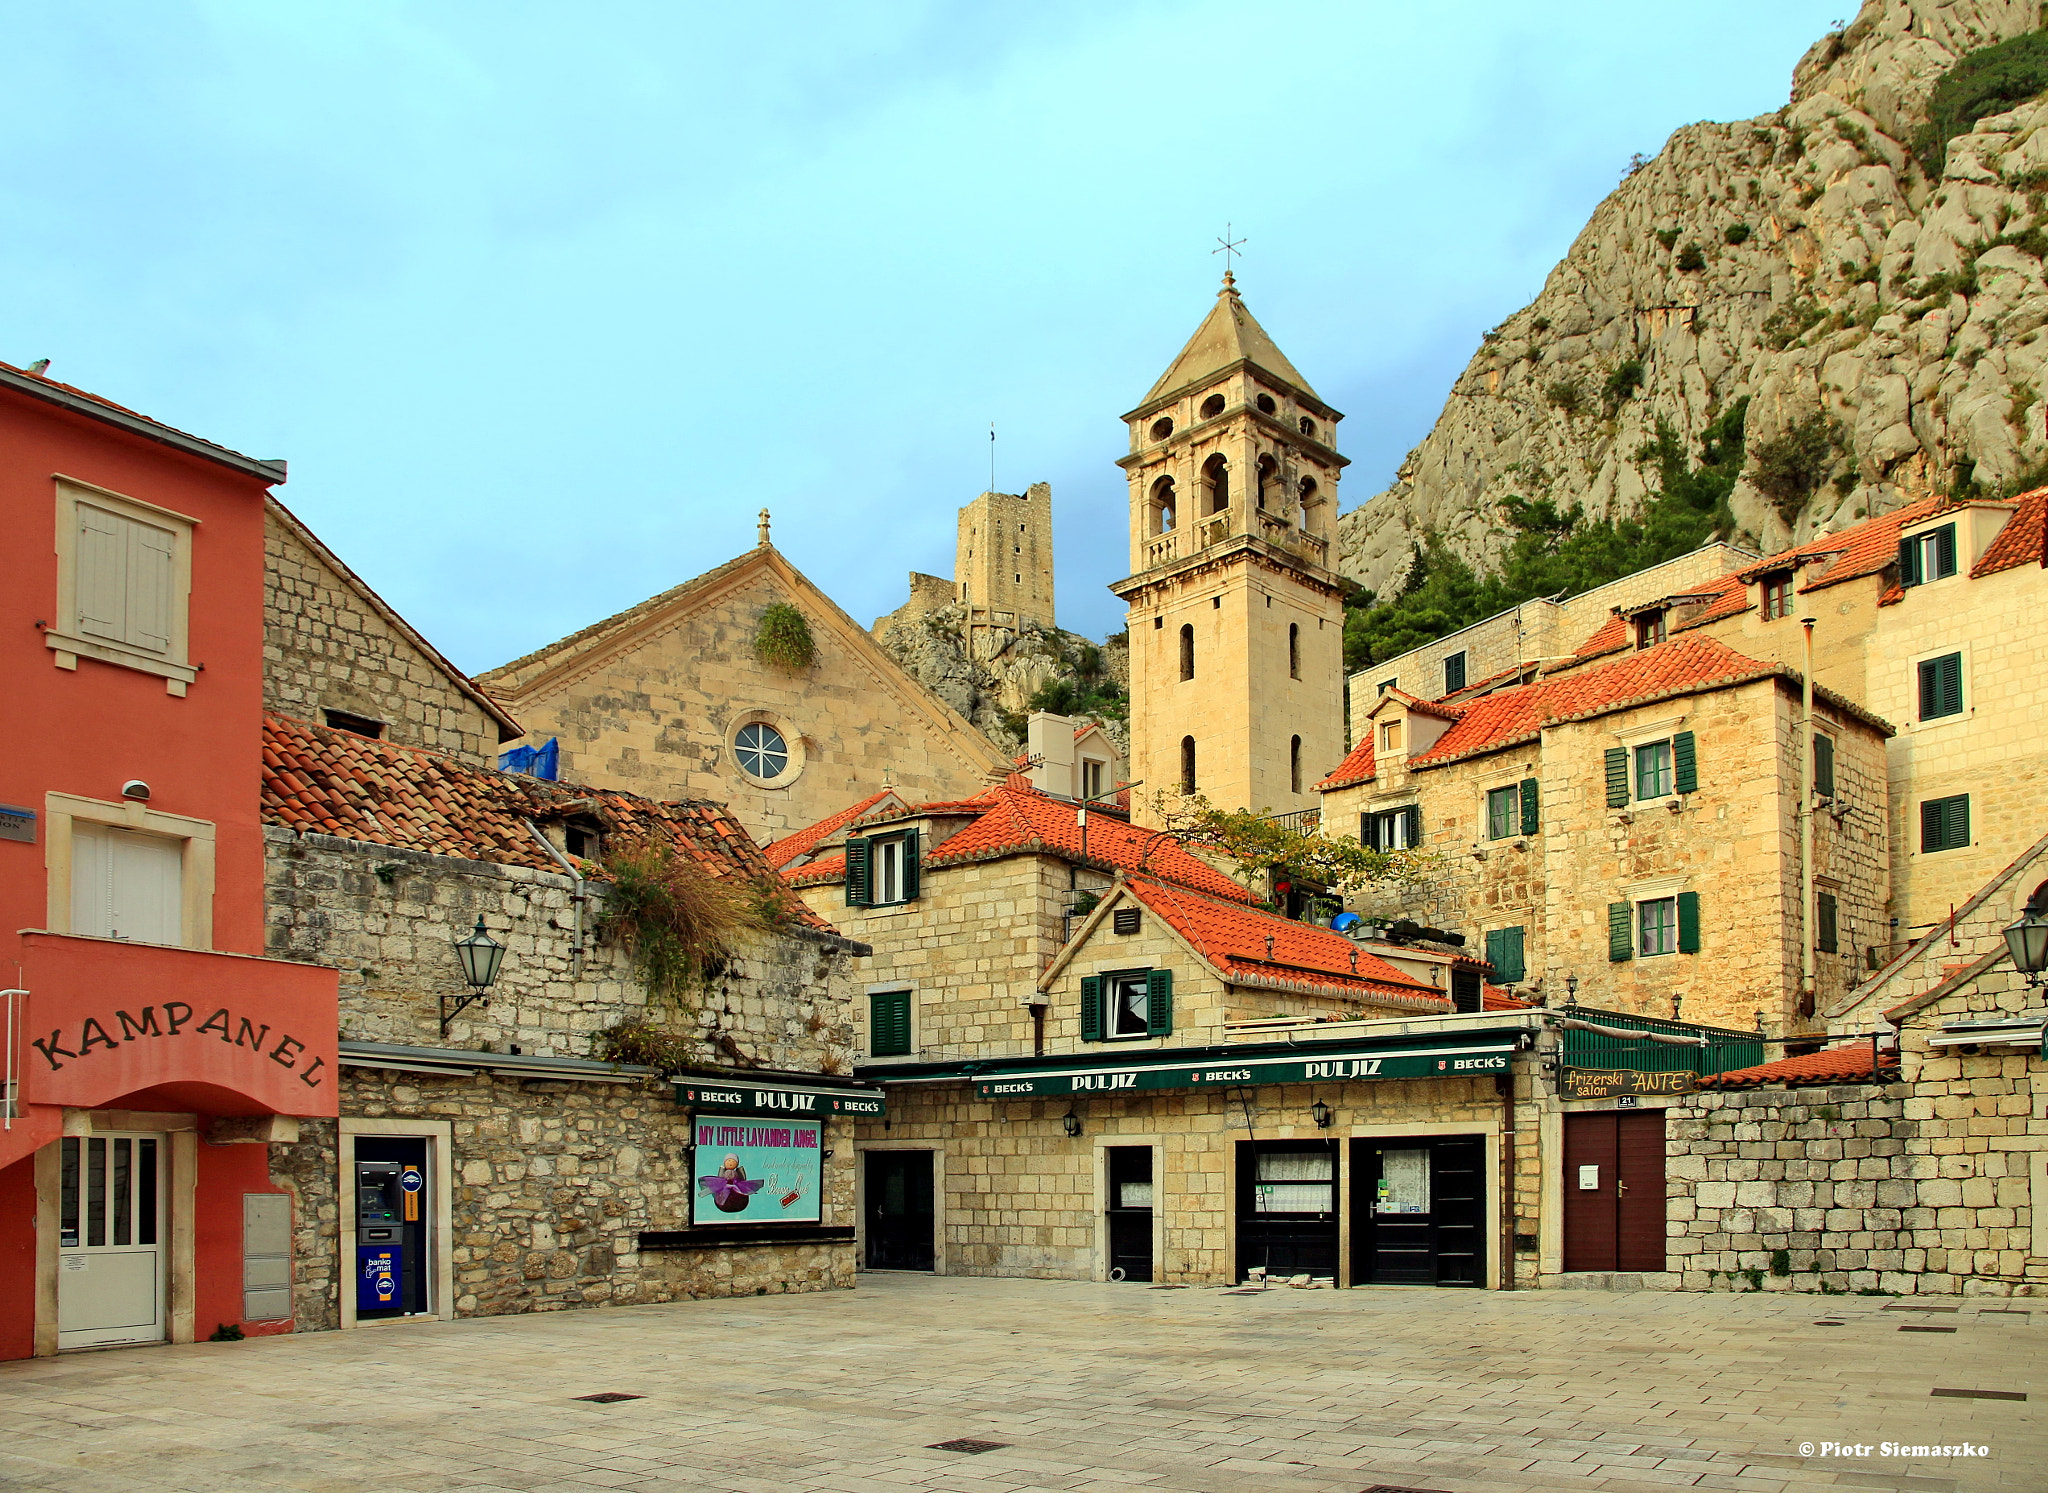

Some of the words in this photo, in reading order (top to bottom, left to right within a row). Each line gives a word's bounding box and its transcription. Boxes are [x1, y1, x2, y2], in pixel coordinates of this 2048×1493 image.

[32, 1001, 325, 1088] KAMPANEL
[994, 1081, 1034, 1093] BECK'S
[1071, 1073, 1137, 1091] PULJIZ
[1205, 1068, 1251, 1081] BECK'S
[1305, 1059, 1382, 1079] PULJIZ
[1453, 1055, 1506, 1070] BECK'S
[1565, 1071, 1623, 1090] frizerski
[1576, 1085, 1607, 1096] salon
[1621, 1096, 1631, 1104] 21
[701, 1091, 742, 1104] BECK'S
[755, 1091, 816, 1111] PULJIZ
[844, 1101, 879, 1112] BECK'S
[699, 1125, 714, 1146] MY
[717, 1126, 745, 1146] LITTLE
[746, 1127, 791, 1148] LAVANDER
[793, 1129, 818, 1148] ANGEL
[368, 1258, 391, 1266] banko
